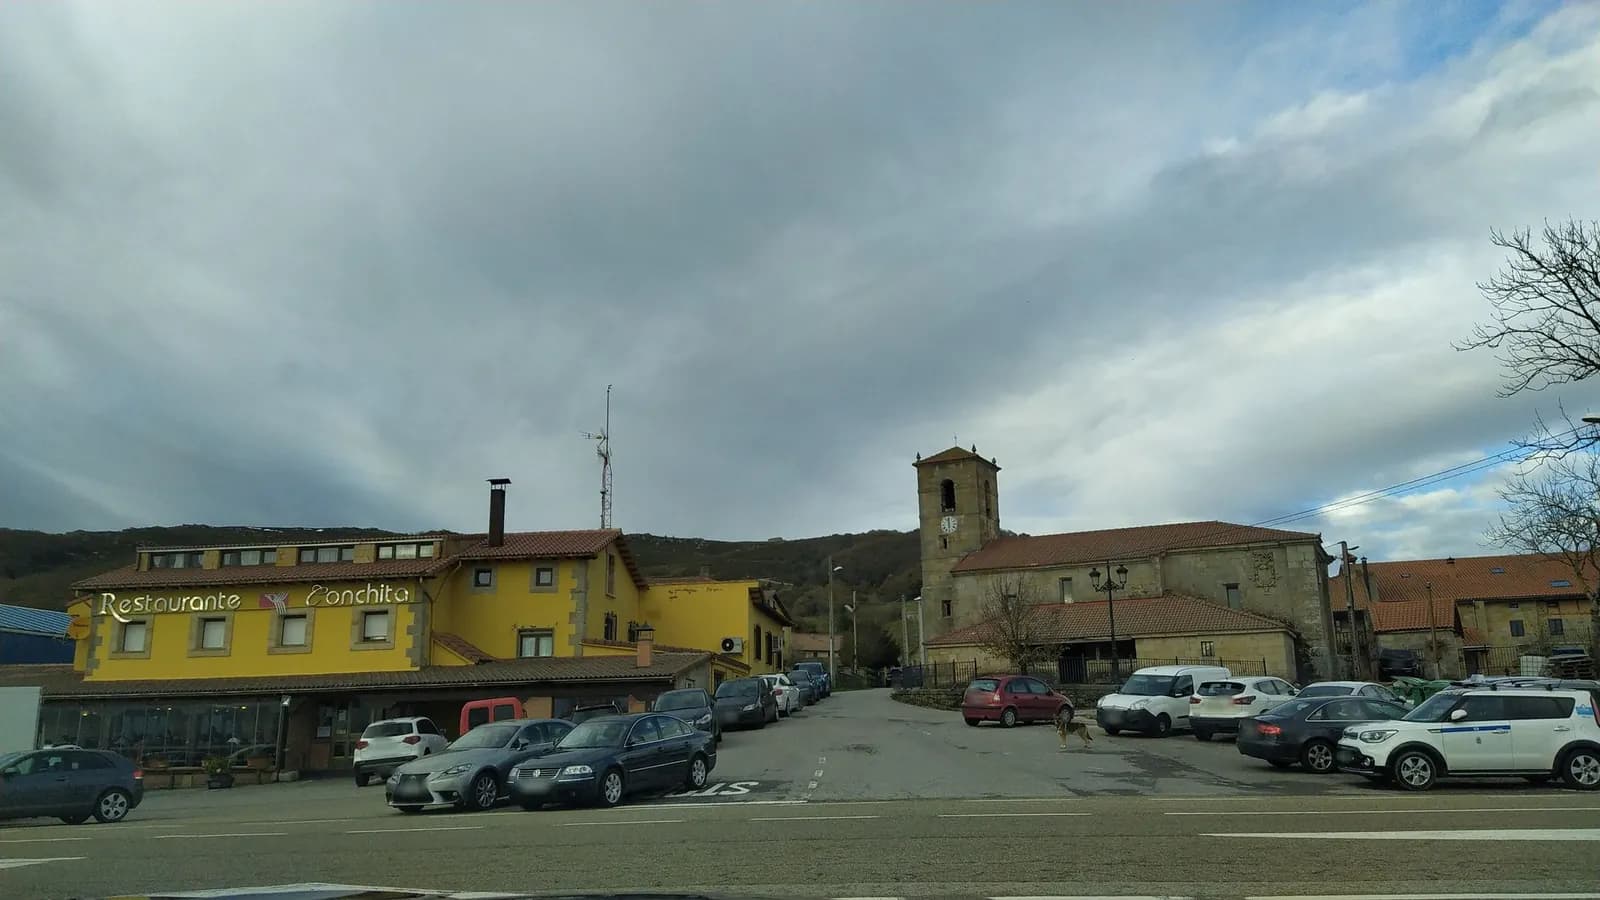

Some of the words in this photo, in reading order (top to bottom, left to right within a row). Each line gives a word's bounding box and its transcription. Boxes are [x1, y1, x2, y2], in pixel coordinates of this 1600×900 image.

[100, 592, 241, 622] Restaurante
[306, 583, 409, 605] Conchita
[664, 782, 759, 798] ST
